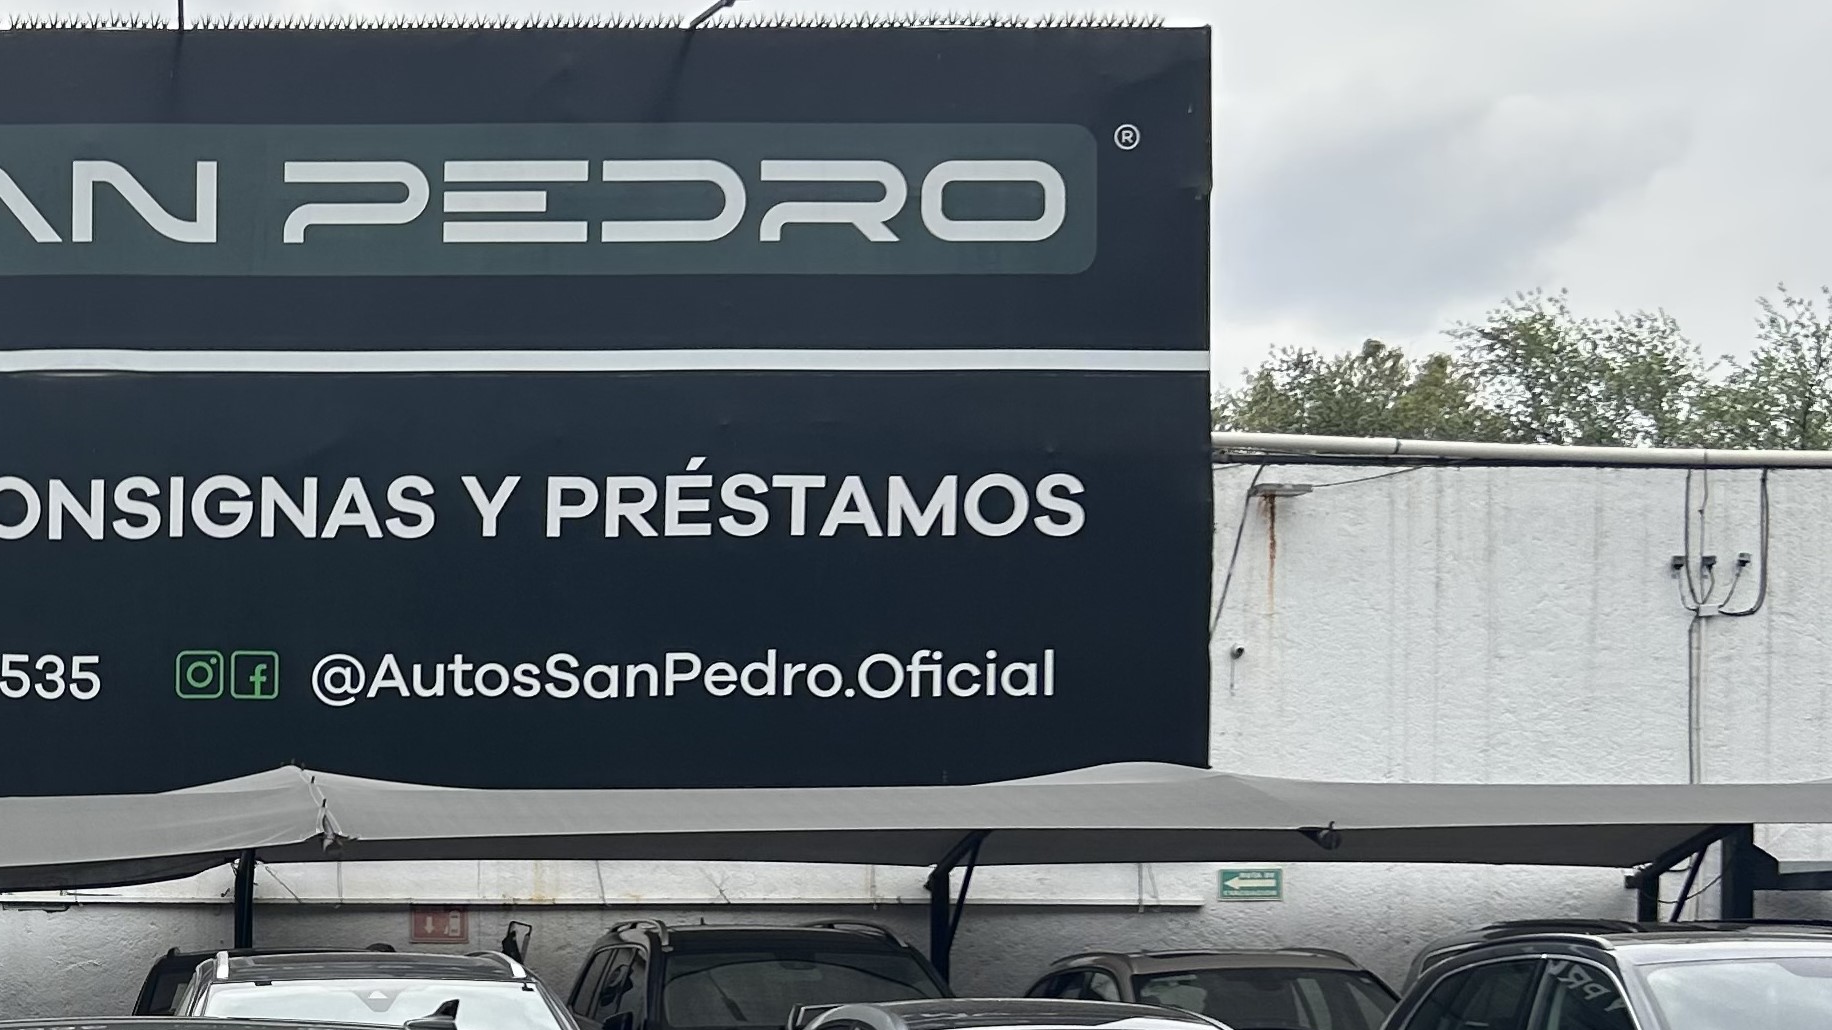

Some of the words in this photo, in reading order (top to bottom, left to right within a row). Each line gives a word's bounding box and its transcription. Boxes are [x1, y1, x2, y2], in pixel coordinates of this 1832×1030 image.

[284, 160, 1065, 243] PEDRO
[461, 476, 521, 537] Y
[546, 457, 1085, 538] PRÉSTAMOS
[311, 649, 1055, 706] @AutosSanPedro.Oficial
